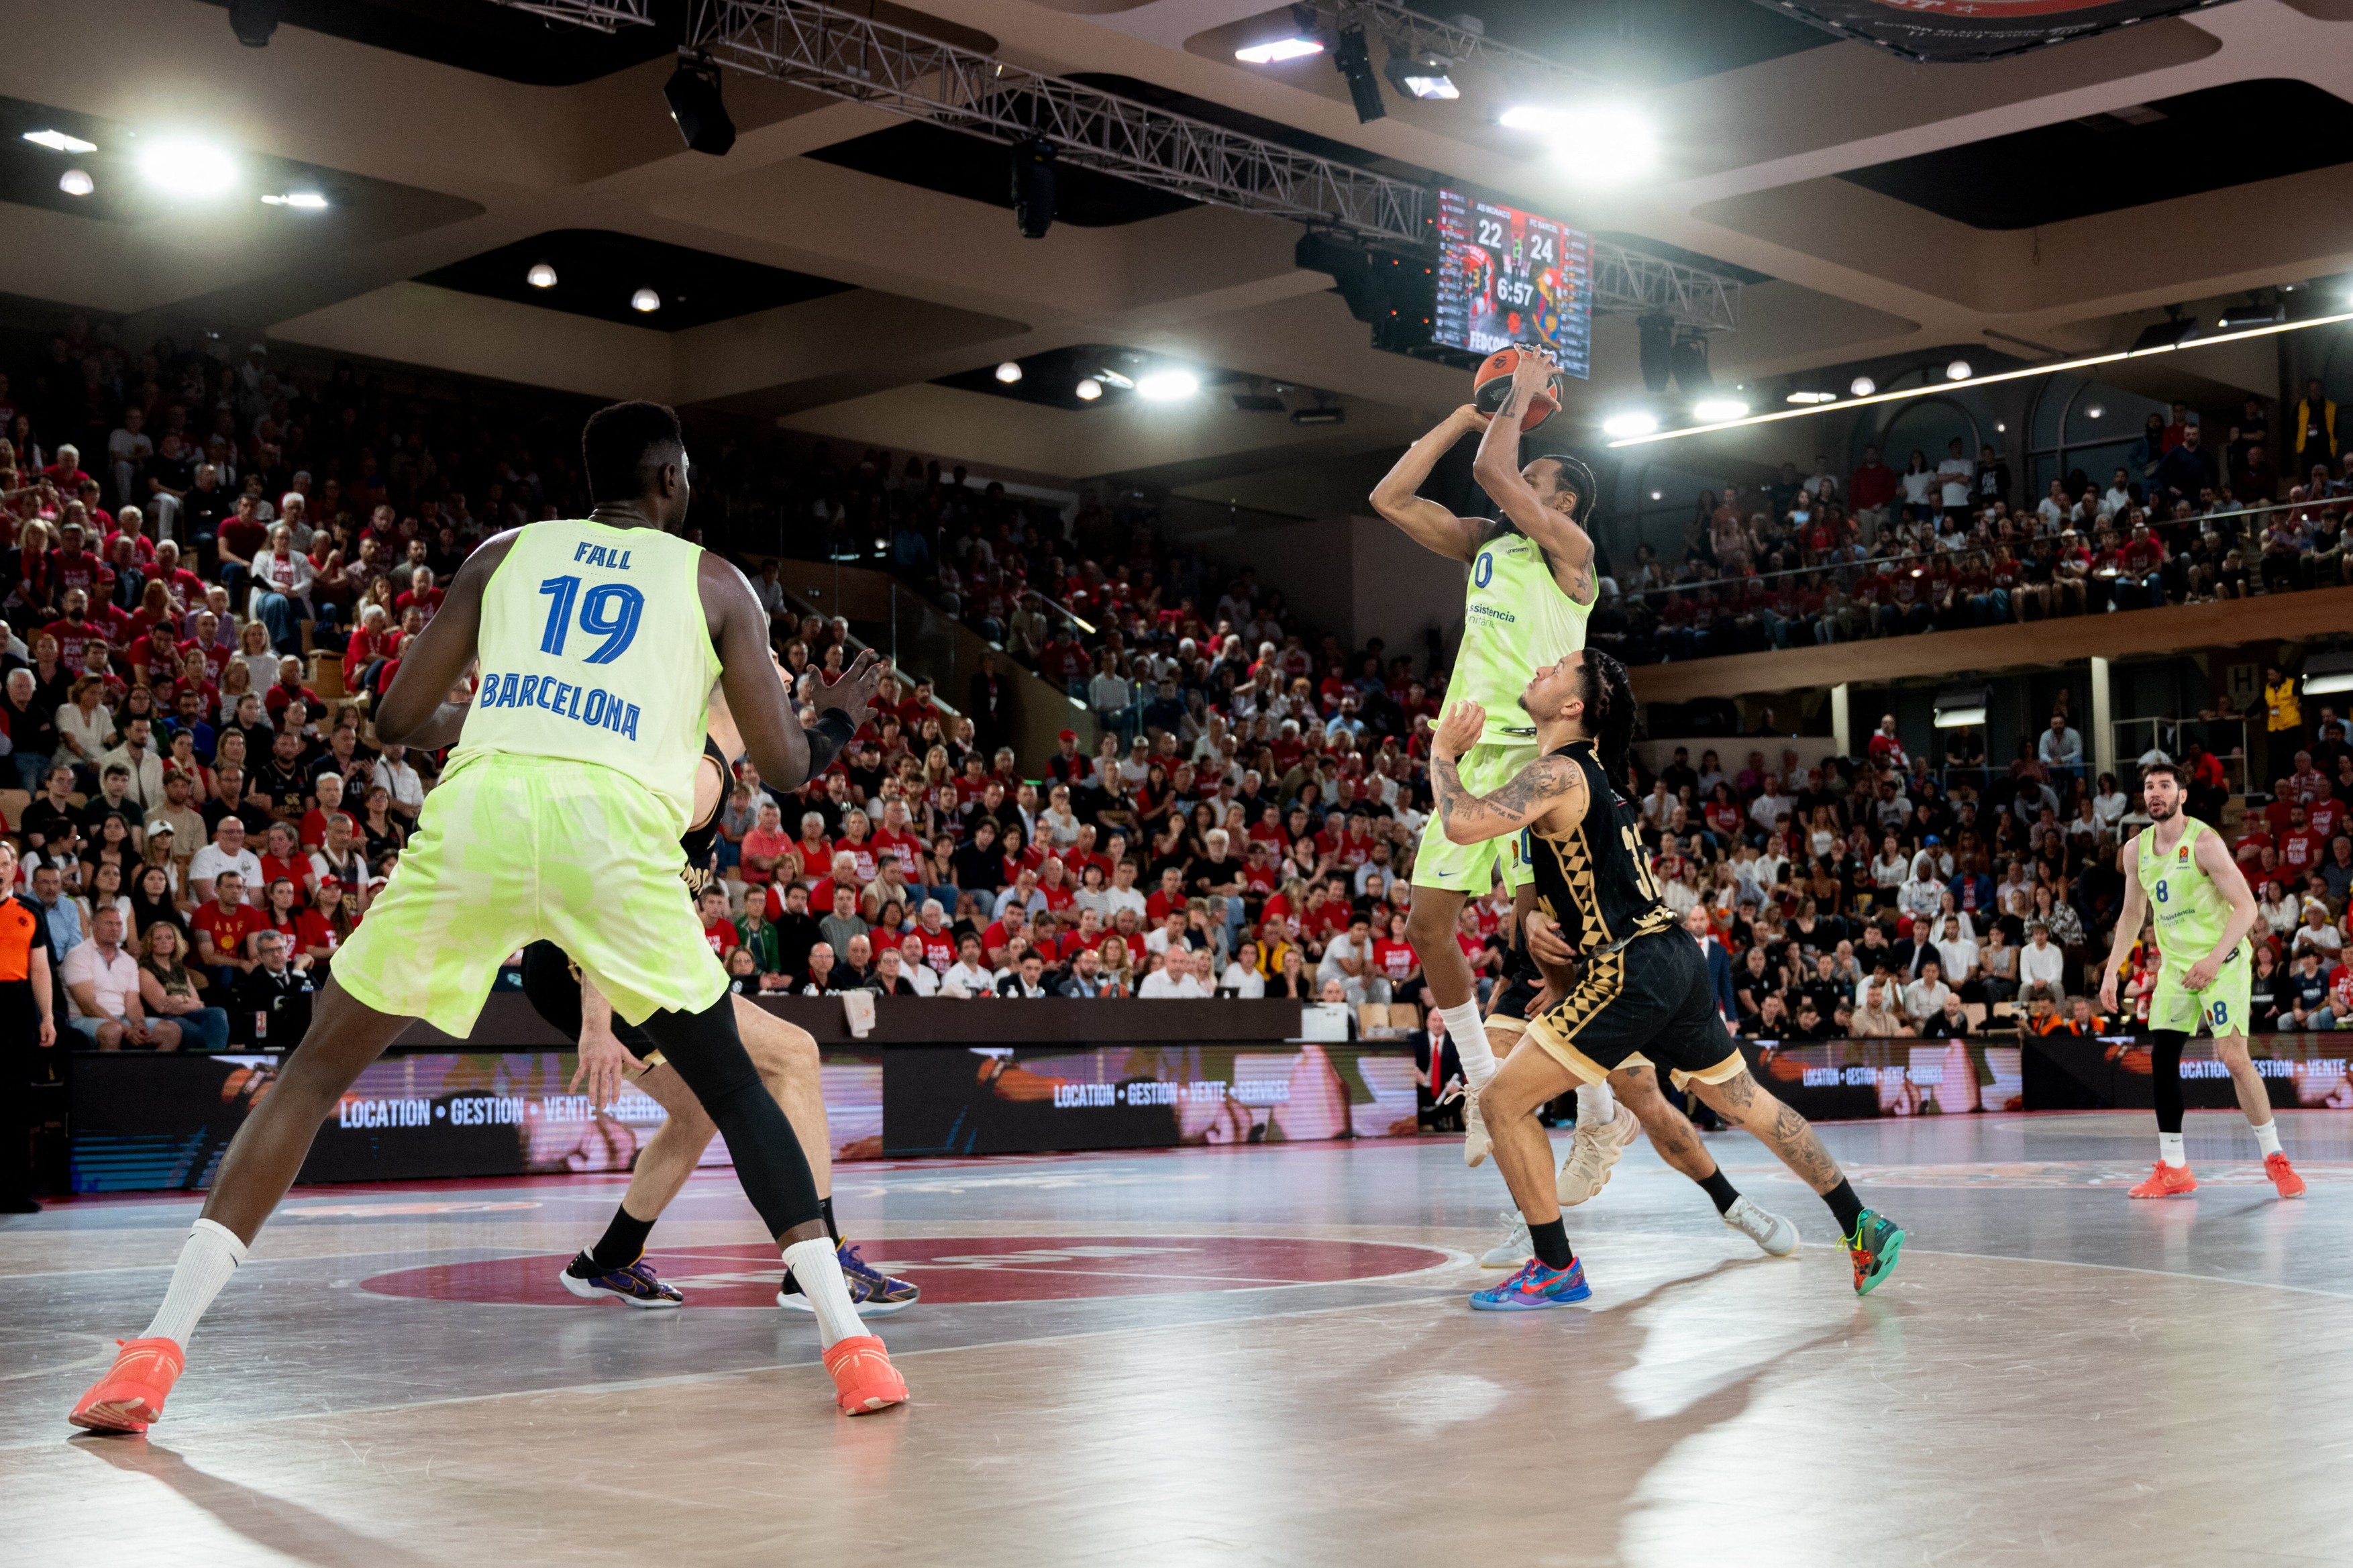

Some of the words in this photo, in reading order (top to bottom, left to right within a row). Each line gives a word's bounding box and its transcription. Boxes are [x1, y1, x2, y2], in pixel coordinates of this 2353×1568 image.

[1478, 219, 1502, 249] 22
[1530, 234, 1554, 263] 24
[1497, 277, 1534, 307] 6:57
[574, 541, 632, 570] FALL
[1475, 552, 1493, 588] 0
[539, 575, 645, 665] 19
[1465, 604, 1516, 623] ssistència
[2234, 666, 2252, 693] H
[480, 673, 641, 741] BARCELONA
[2156, 879, 2168, 903] 8
[2213, 1000, 2228, 1026] 8
[1803, 1067, 1840, 1087] LOCATION
[1846, 1067, 1877, 1086] GESTION
[1883, 1065, 1905, 1084] VENTE
[2180, 1059, 2231, 1079] OCATION
[2252, 1059, 2294, 1078] ESTION
[2307, 1059, 2346, 1077] VENTE
[1054, 1084, 1115, 1108] LOCATION
[1127, 1082, 1178, 1106] GESTION
[1190, 1080, 1227, 1102] VENTE
[1237, 1080, 1290, 1102] SERVICES
[340, 1098, 431, 1129] LOCATION
[451, 1096, 525, 1125] GESTION
[543, 1094, 597, 1122] VENTE
